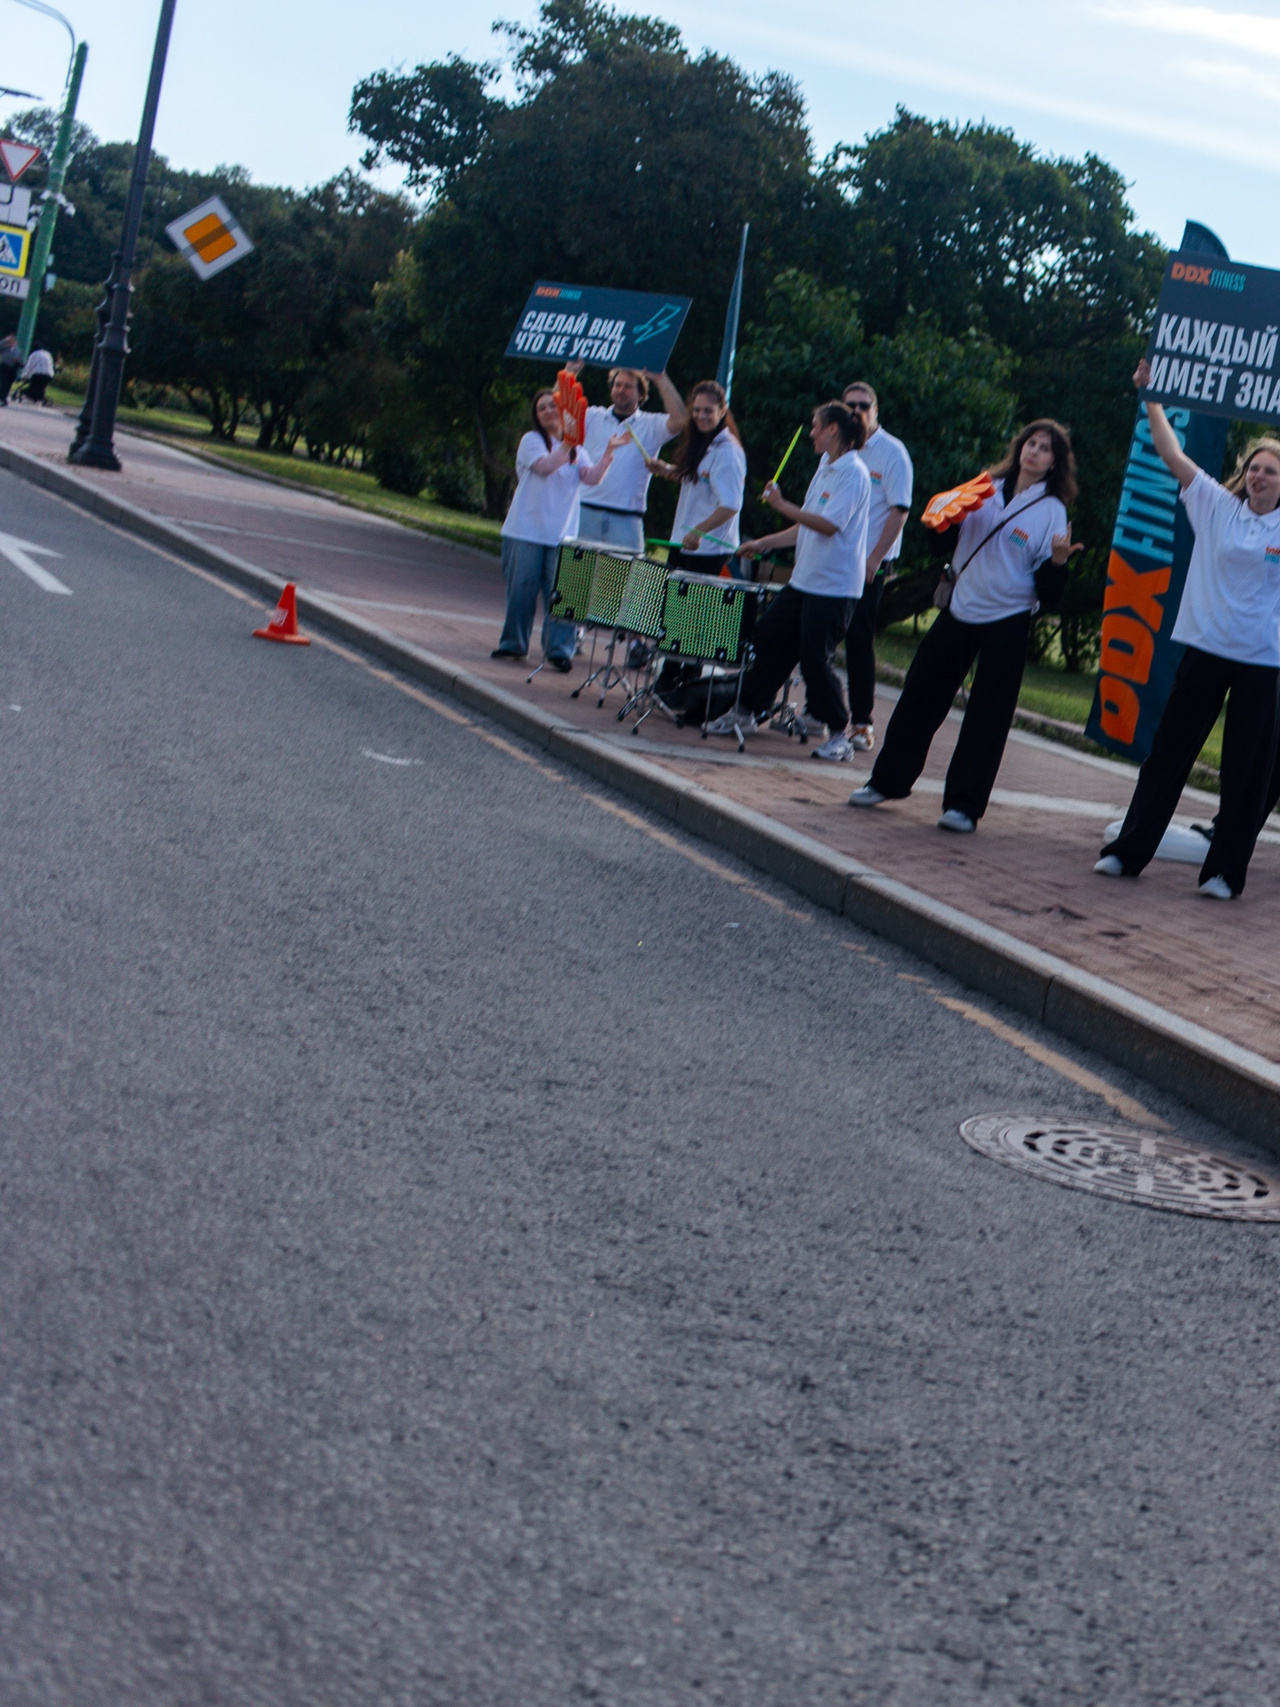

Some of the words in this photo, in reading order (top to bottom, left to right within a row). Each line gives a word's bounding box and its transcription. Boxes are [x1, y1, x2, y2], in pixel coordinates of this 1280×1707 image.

[514, 331, 547, 352] ЧТО
[545, 334, 568, 357] НЕ
[568, 337, 624, 362] УСТАЛ
[522, 310, 589, 336] СДЕЛАЙ
[587, 317, 627, 342] ВИД,
[1155, 312, 1279, 370] КАЖДЫЙ
[1146, 354, 1233, 404] ИМЕЕТ
[1099, 548, 1172, 746] DDX
